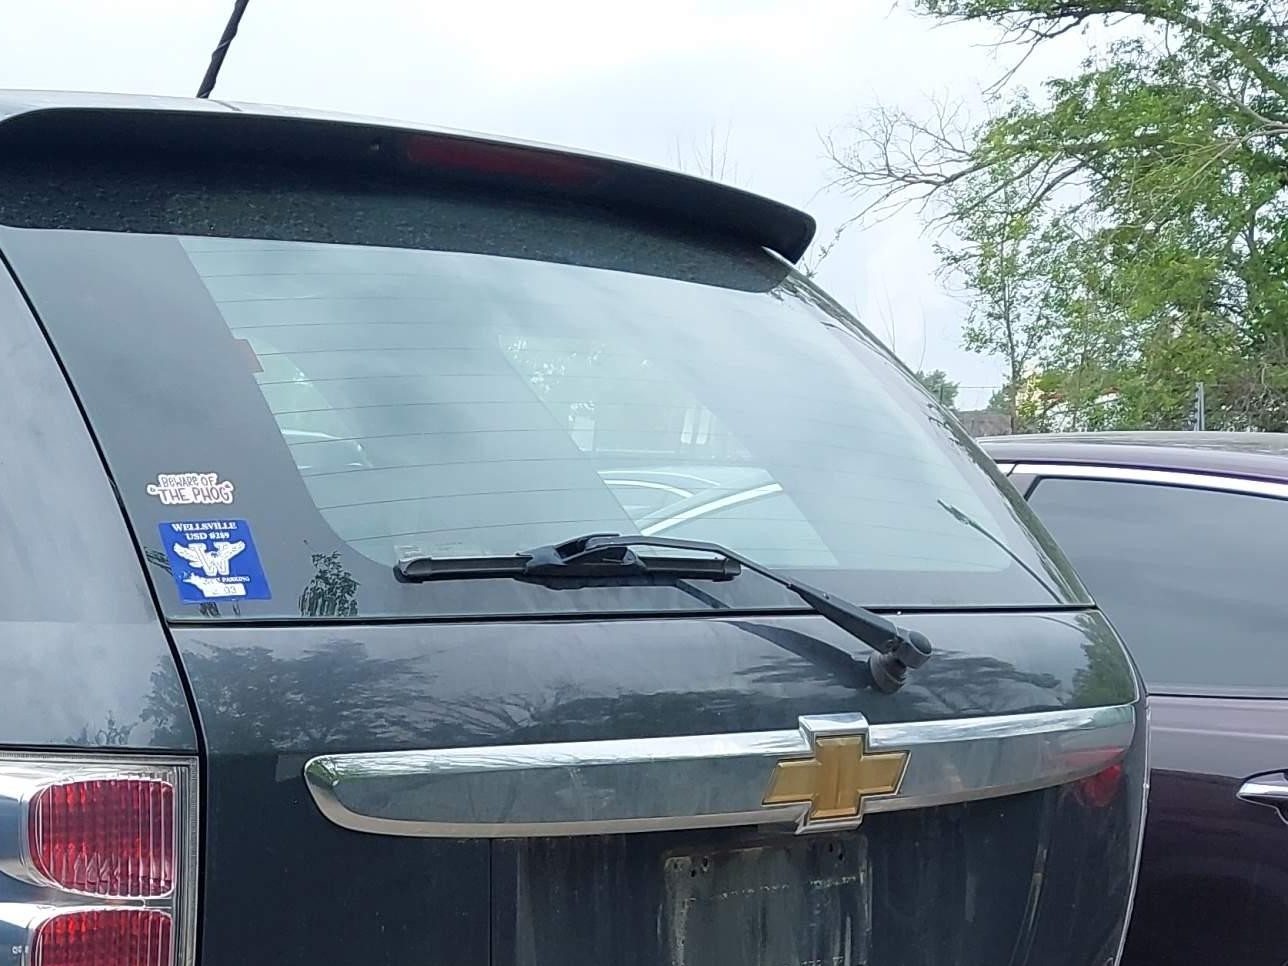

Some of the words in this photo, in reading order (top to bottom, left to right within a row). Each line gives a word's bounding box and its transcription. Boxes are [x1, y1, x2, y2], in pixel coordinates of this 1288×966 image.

[160, 476, 199, 487] BEWARE
[201, 475, 215, 487] OF
[158, 488, 191, 501] THE
[192, 486, 230, 502] PHOG
[171, 522, 237, 532] WELLSVILLE
[185, 532, 208, 541] USD
